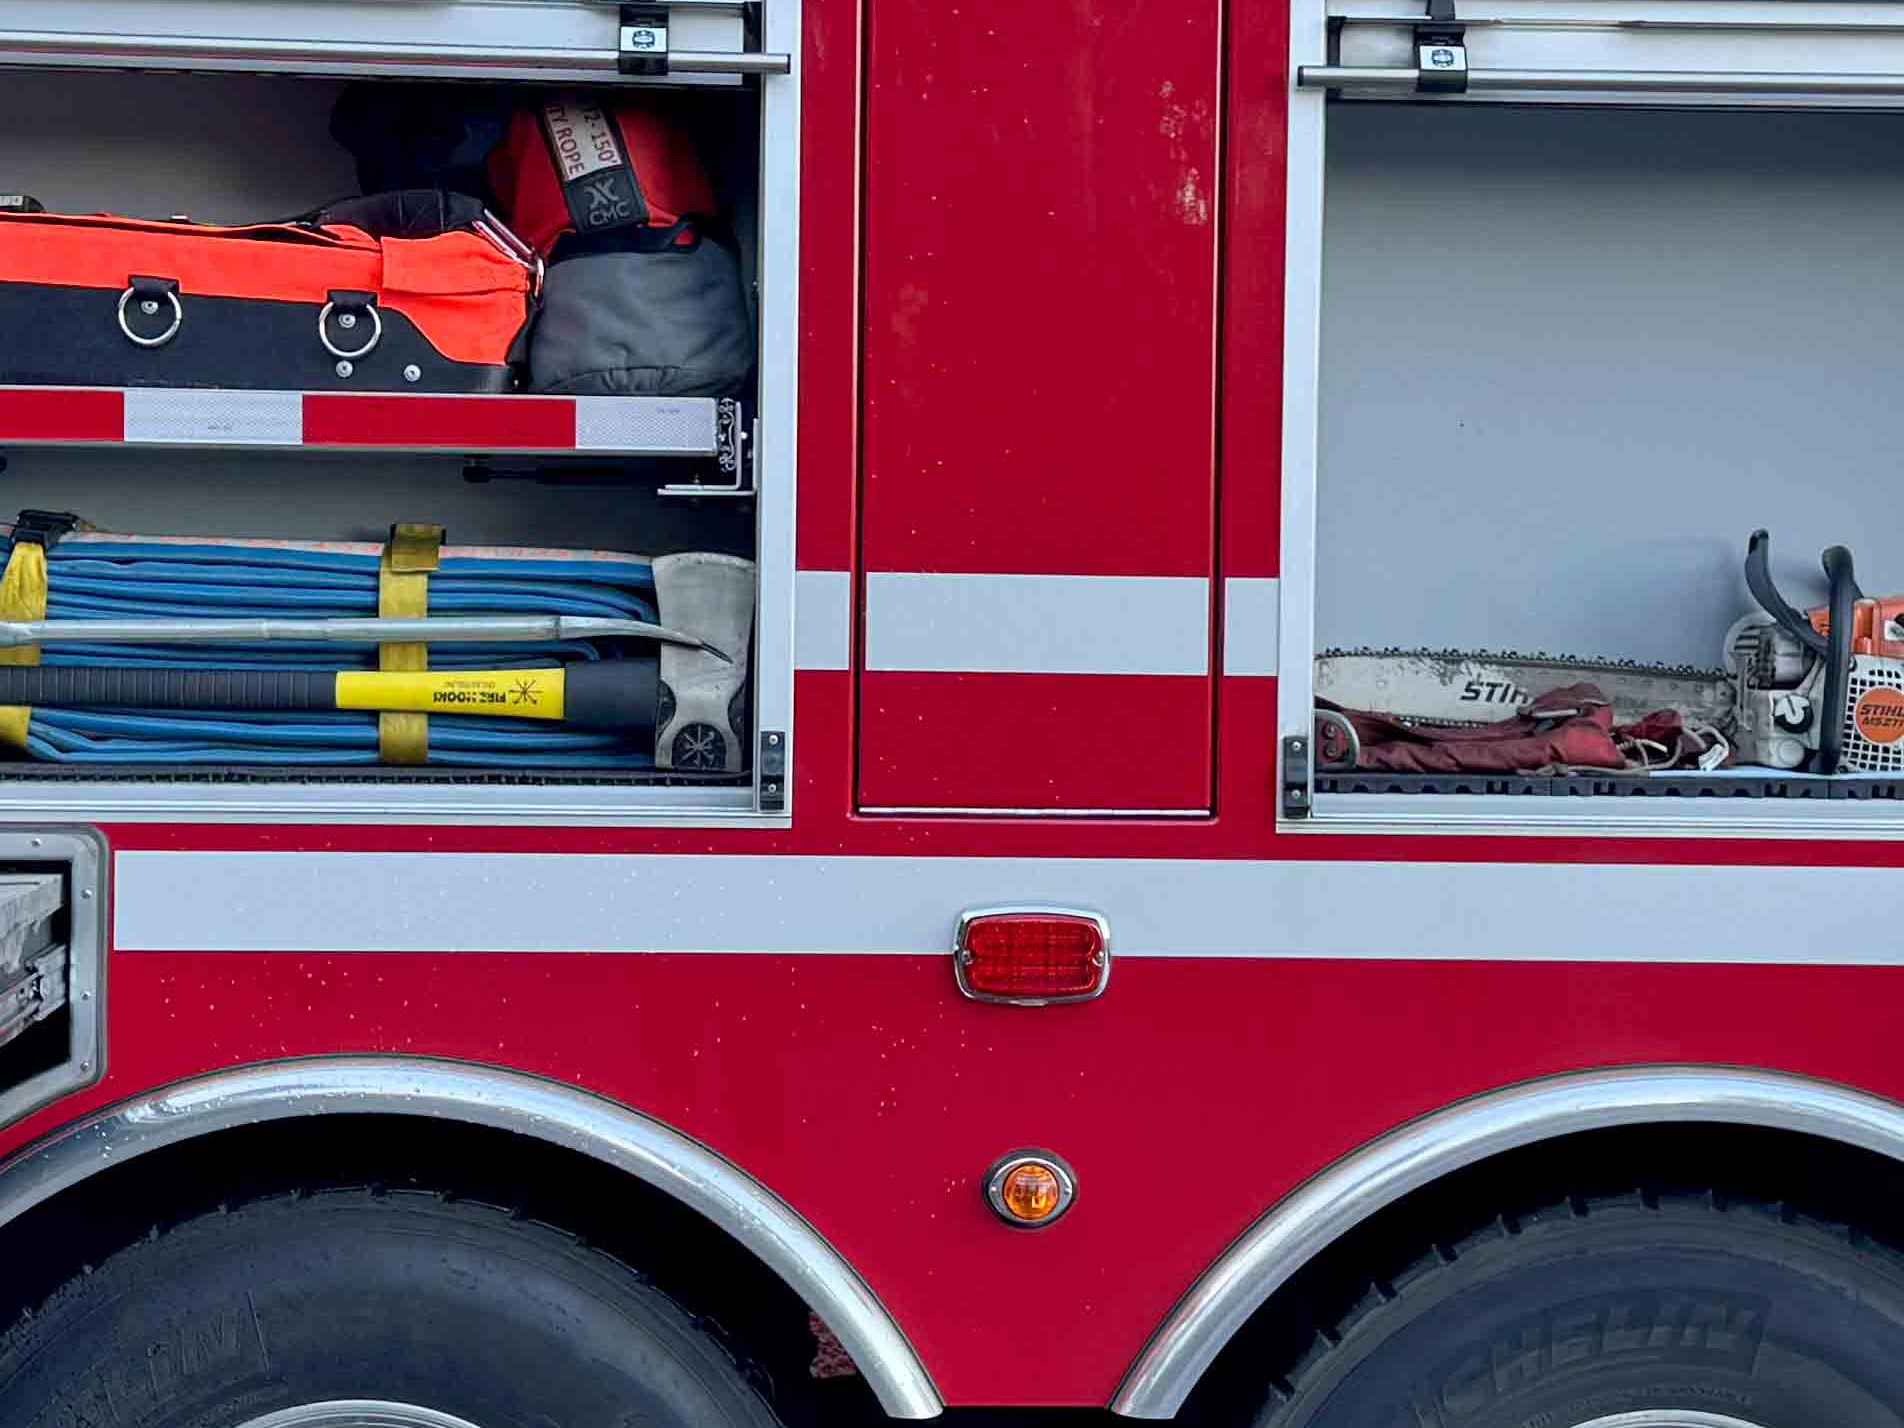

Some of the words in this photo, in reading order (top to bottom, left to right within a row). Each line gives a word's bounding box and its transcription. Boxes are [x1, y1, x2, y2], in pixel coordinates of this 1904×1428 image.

[555, 126, 585, 175] ROPE
[590, 131, 619, 164] 150'
[589, 201, 632, 226] CMC
[1459, 680, 1530, 705] STIH
